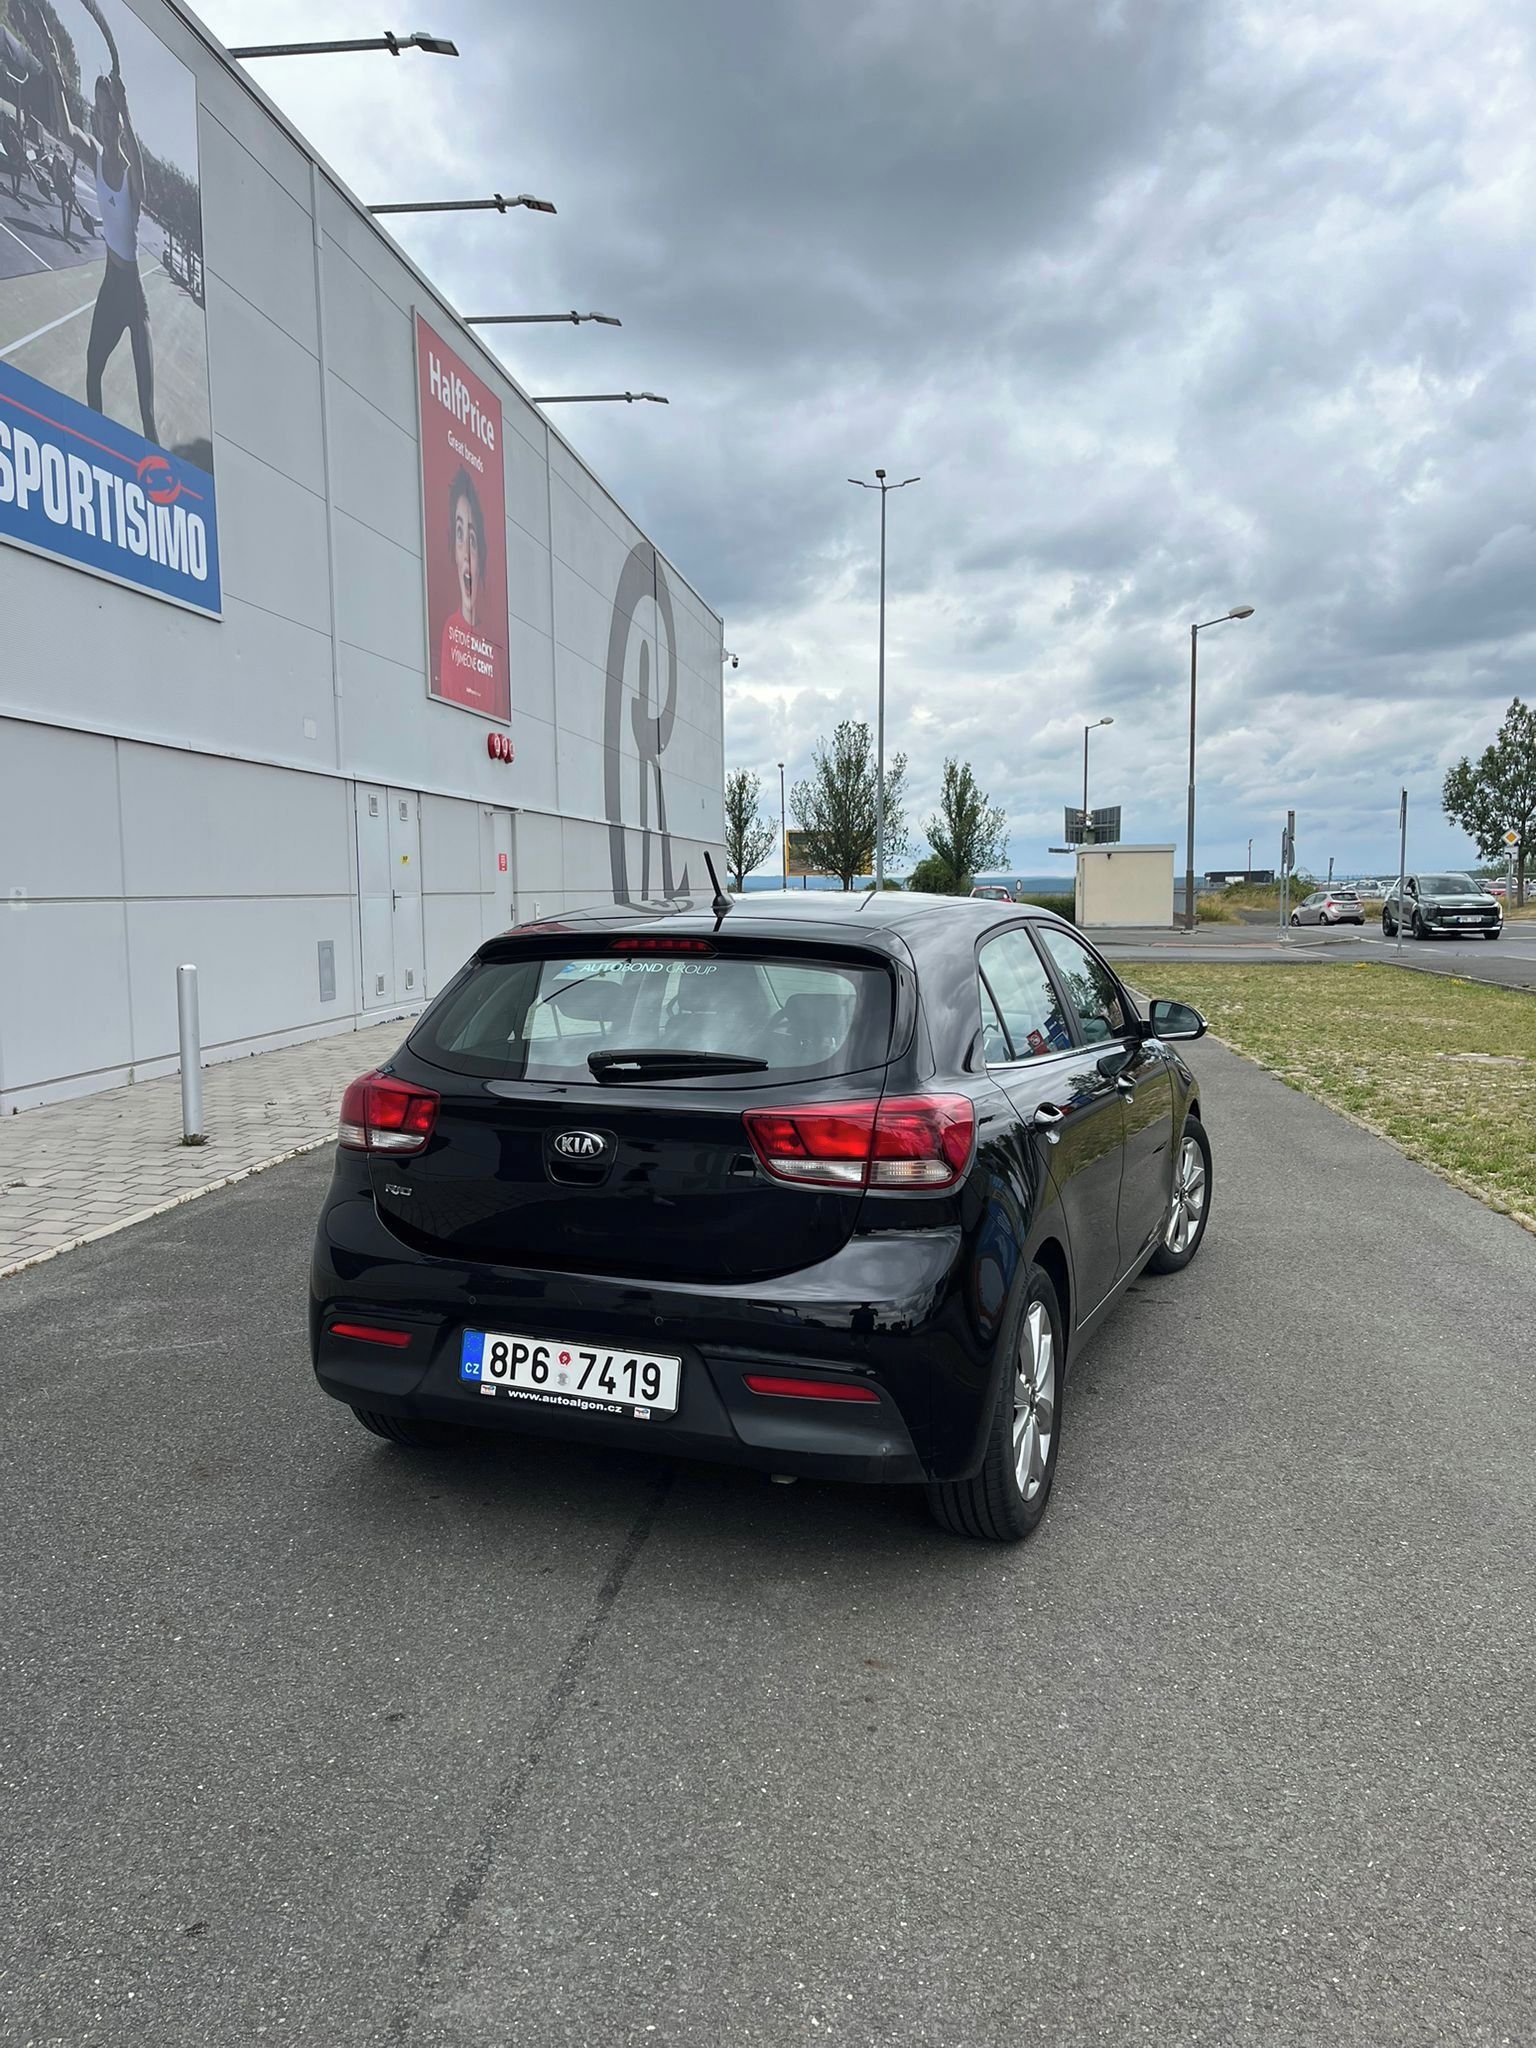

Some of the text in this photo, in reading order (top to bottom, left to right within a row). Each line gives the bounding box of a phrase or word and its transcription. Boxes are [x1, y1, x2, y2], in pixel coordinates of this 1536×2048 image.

[428, 351, 495, 451] HalfPrice
[448, 430, 483, 473] Great brands
[579, 962, 717, 975] AUTOBOND GROUP
[561, 1136, 595, 1154] KIA
[465, 1362, 480, 1375] CZ
[489, 1341, 661, 1401] 8P6 7419
[508, 1389, 622, 1413] www.autoalgon.cz
